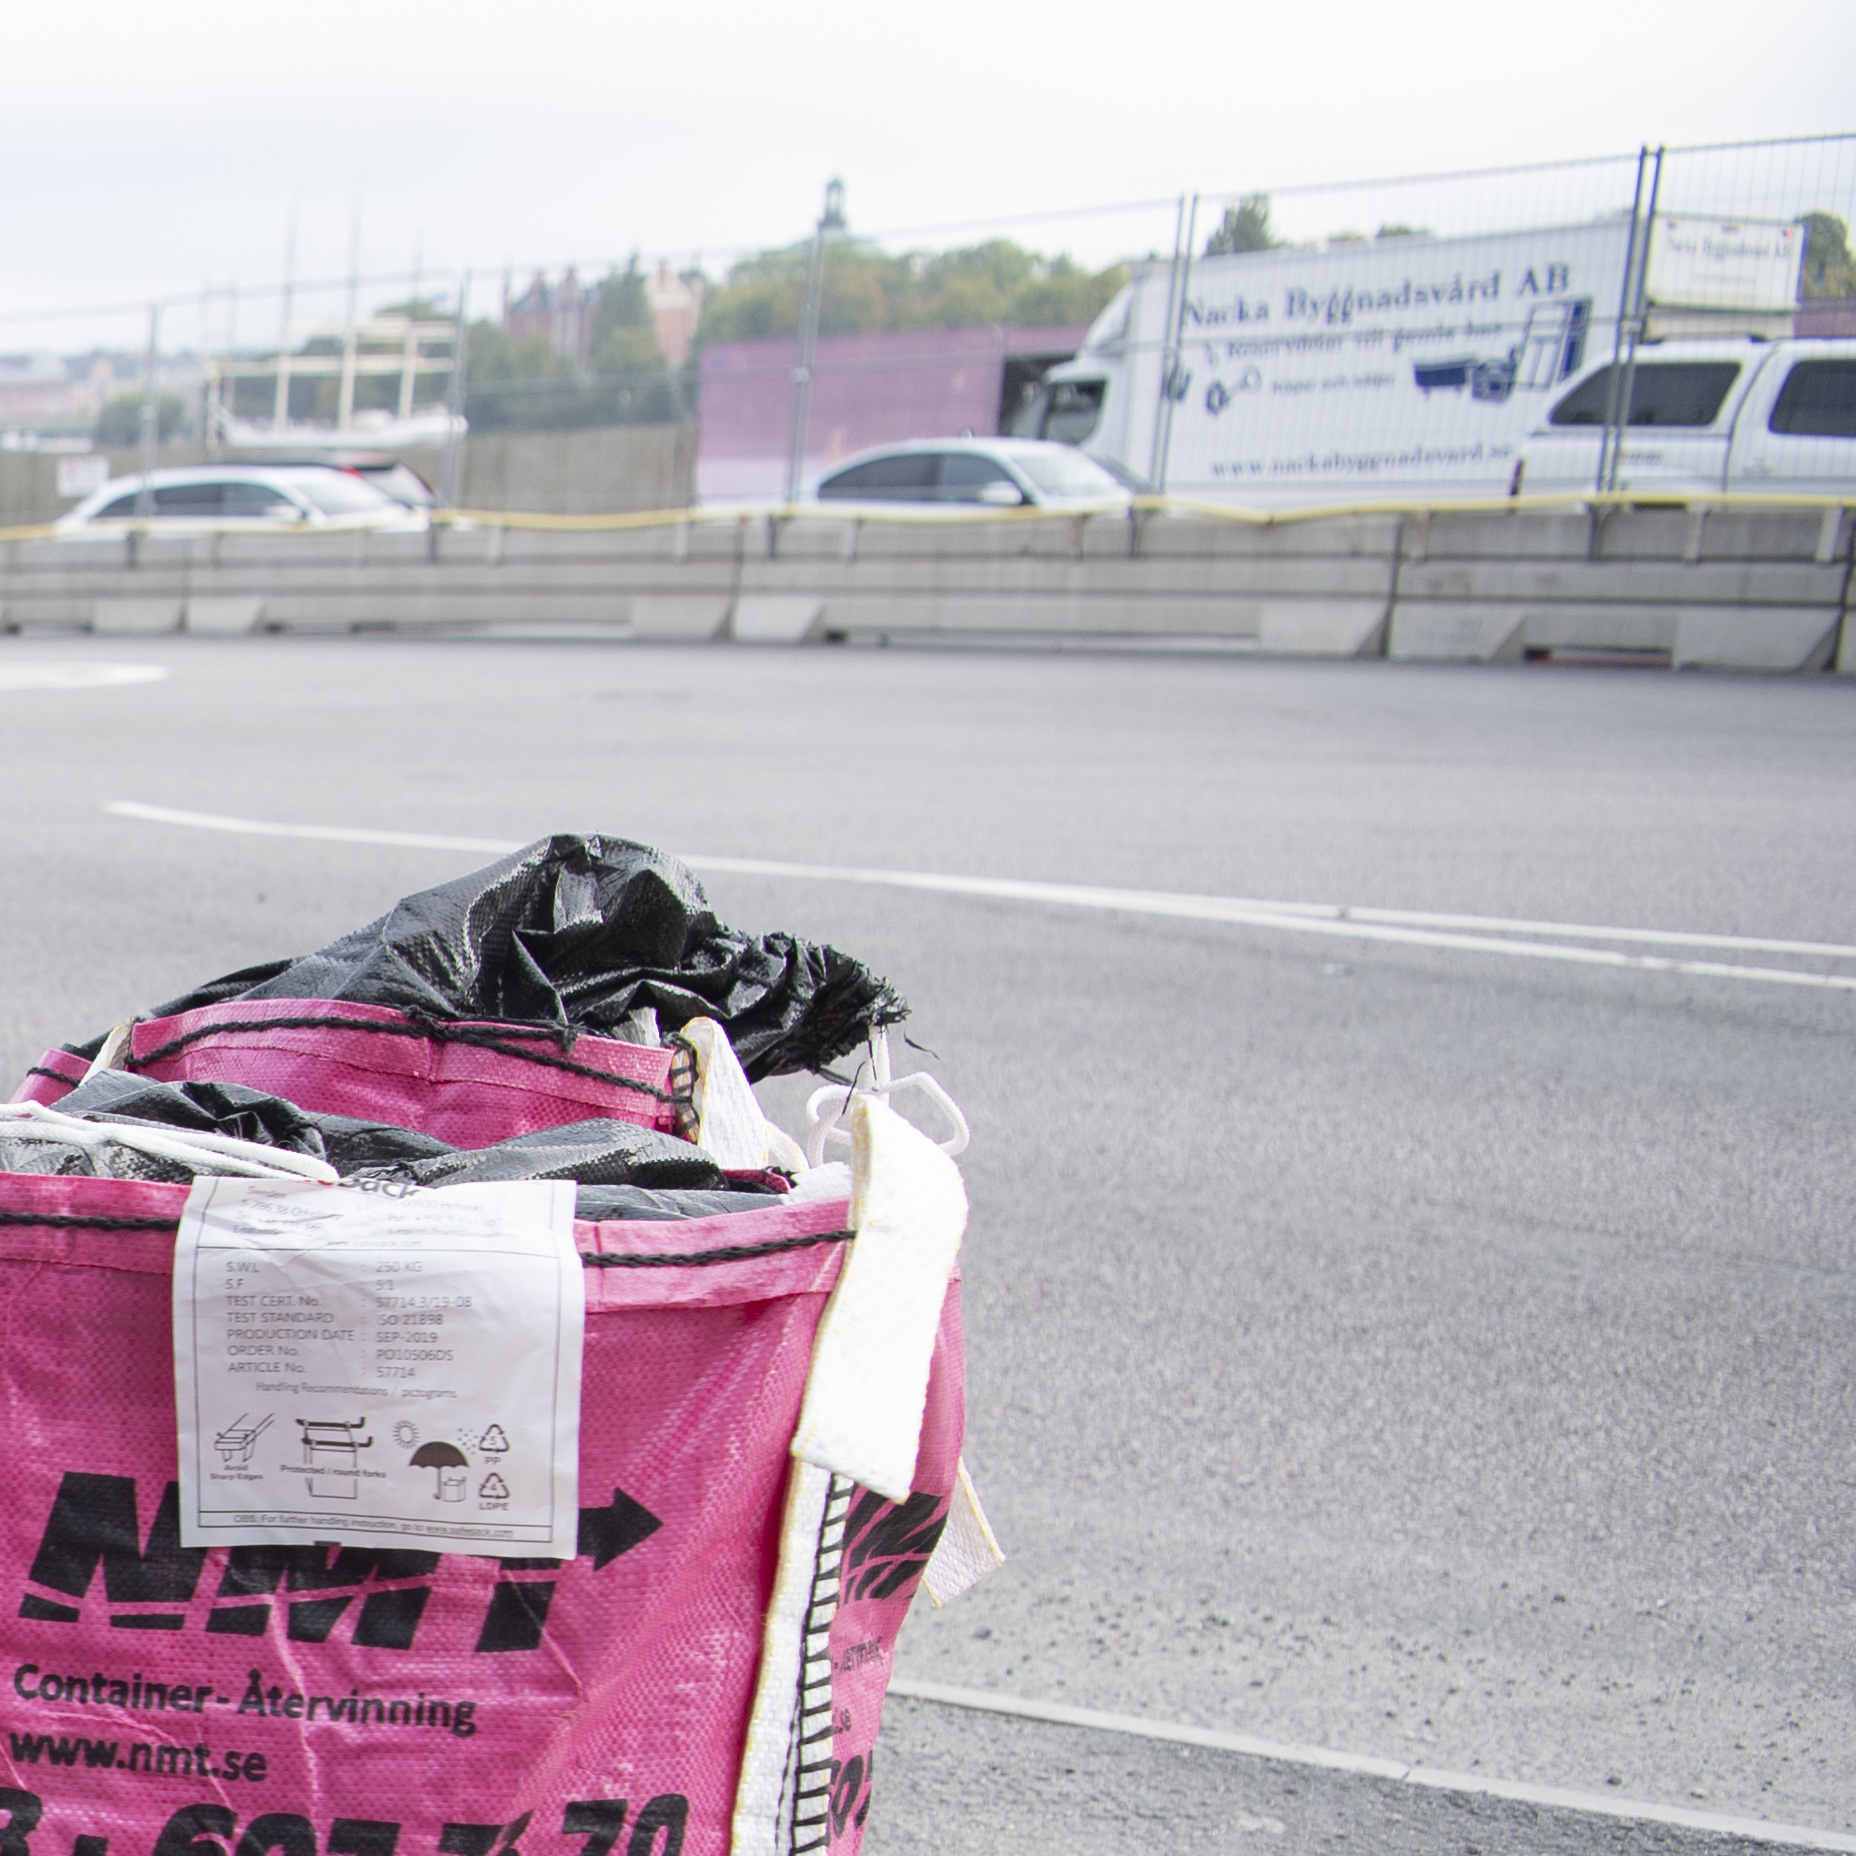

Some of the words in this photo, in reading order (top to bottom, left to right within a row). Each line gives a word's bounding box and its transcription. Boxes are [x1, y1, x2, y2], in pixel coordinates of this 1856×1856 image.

[1186, 297, 1269, 327] Nacka
[1287, 270, 1501, 325] Byggnadsvård
[1518, 263, 1570, 295] AB
[376, 1261, 400, 1273] 250
[226, 1295, 256, 1306] TEST
[226, 1311, 256, 1323] TEST
[261, 1312, 334, 1324] STANDARD
[227, 1329, 317, 1340] PRODUCTION
[321, 1329, 354, 1341] DATE
[376, 1331, 438, 1343] SEP-2019
[228, 1345, 274, 1356] ORDER
[228, 1362, 281, 1373] ARTICLE
[237, 1669, 478, 1736] Återvinning
[10, 1731, 267, 1781] www.nmt.se
